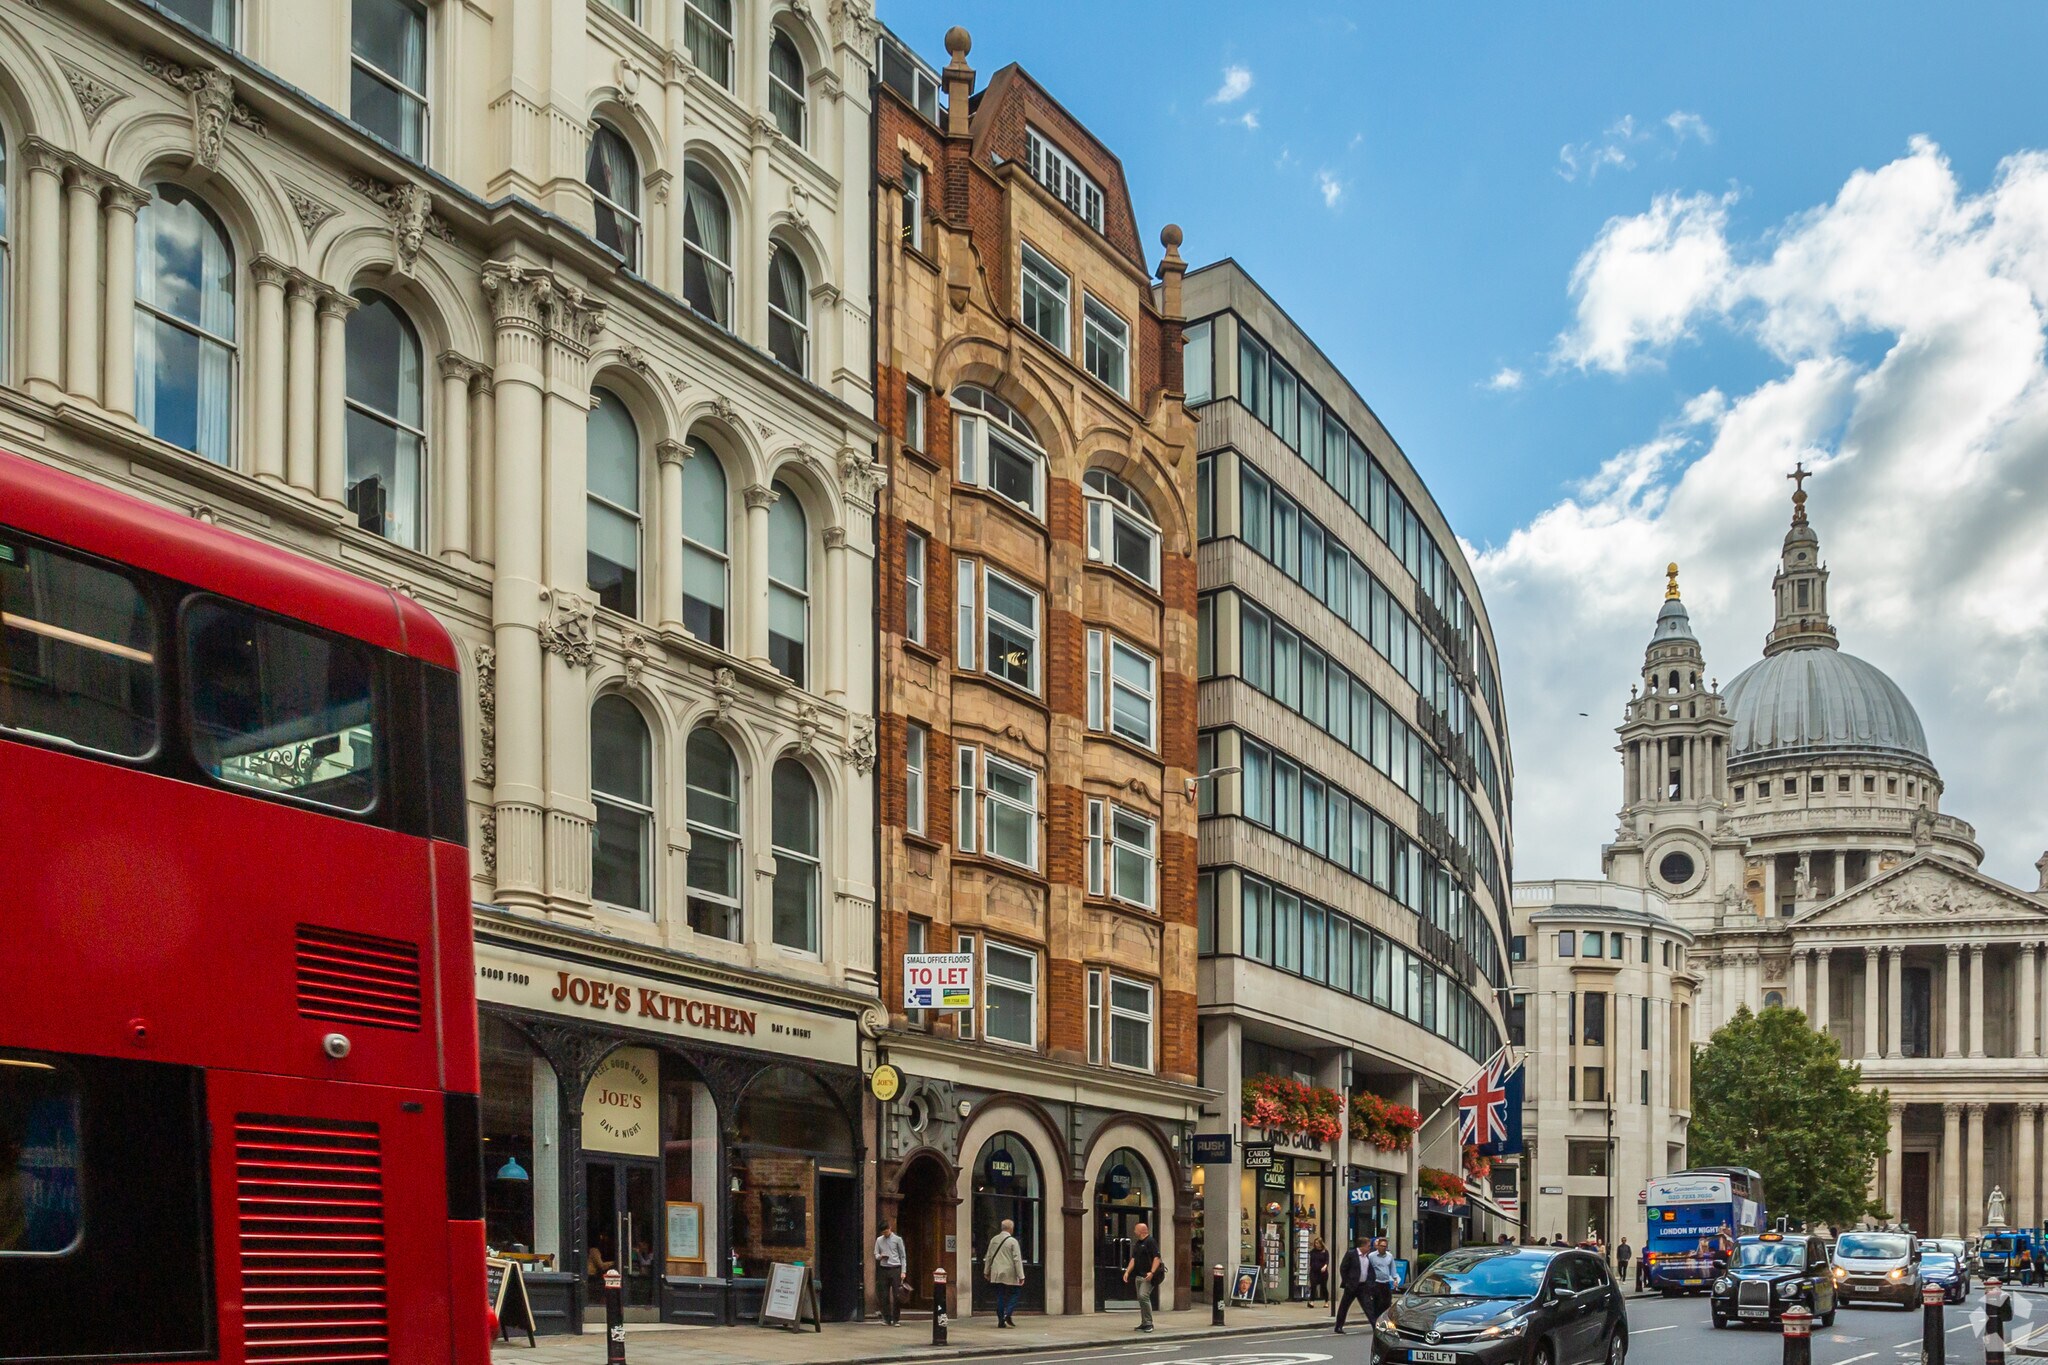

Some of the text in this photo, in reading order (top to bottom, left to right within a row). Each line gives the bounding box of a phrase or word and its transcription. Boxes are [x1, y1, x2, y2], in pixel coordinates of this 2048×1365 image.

[907, 955, 970, 964] SMALL OFFICE FLOORS
[481, 966, 504, 981] GOOD
[507, 971, 530, 986] FOOD
[909, 967, 968, 985] TO LET
[552, 971, 757, 1036] JOE'S KITCHEN
[771, 1022, 812, 1039] DAY & NIGHT
[594, 1060, 648, 1085] FEEL GOOD FOOD
[599, 1089, 642, 1109] JOE'S
[600, 1119, 642, 1138] DAY & NIGHT
[1197, 1141, 1225, 1152] RUSH
[1248, 1150, 1271, 1158] CARDS
[1246, 1157, 1272, 1165] GALORE
[1264, 1173, 1286, 1185] GALORE
[1419, 1200, 1428, 1208] 24
[1660, 1226, 1719, 1236] LONDON BY NIGHT
[947, 1239, 956, 1249] 32
[1416, 1352, 1453, 1362] LX16 LFY
